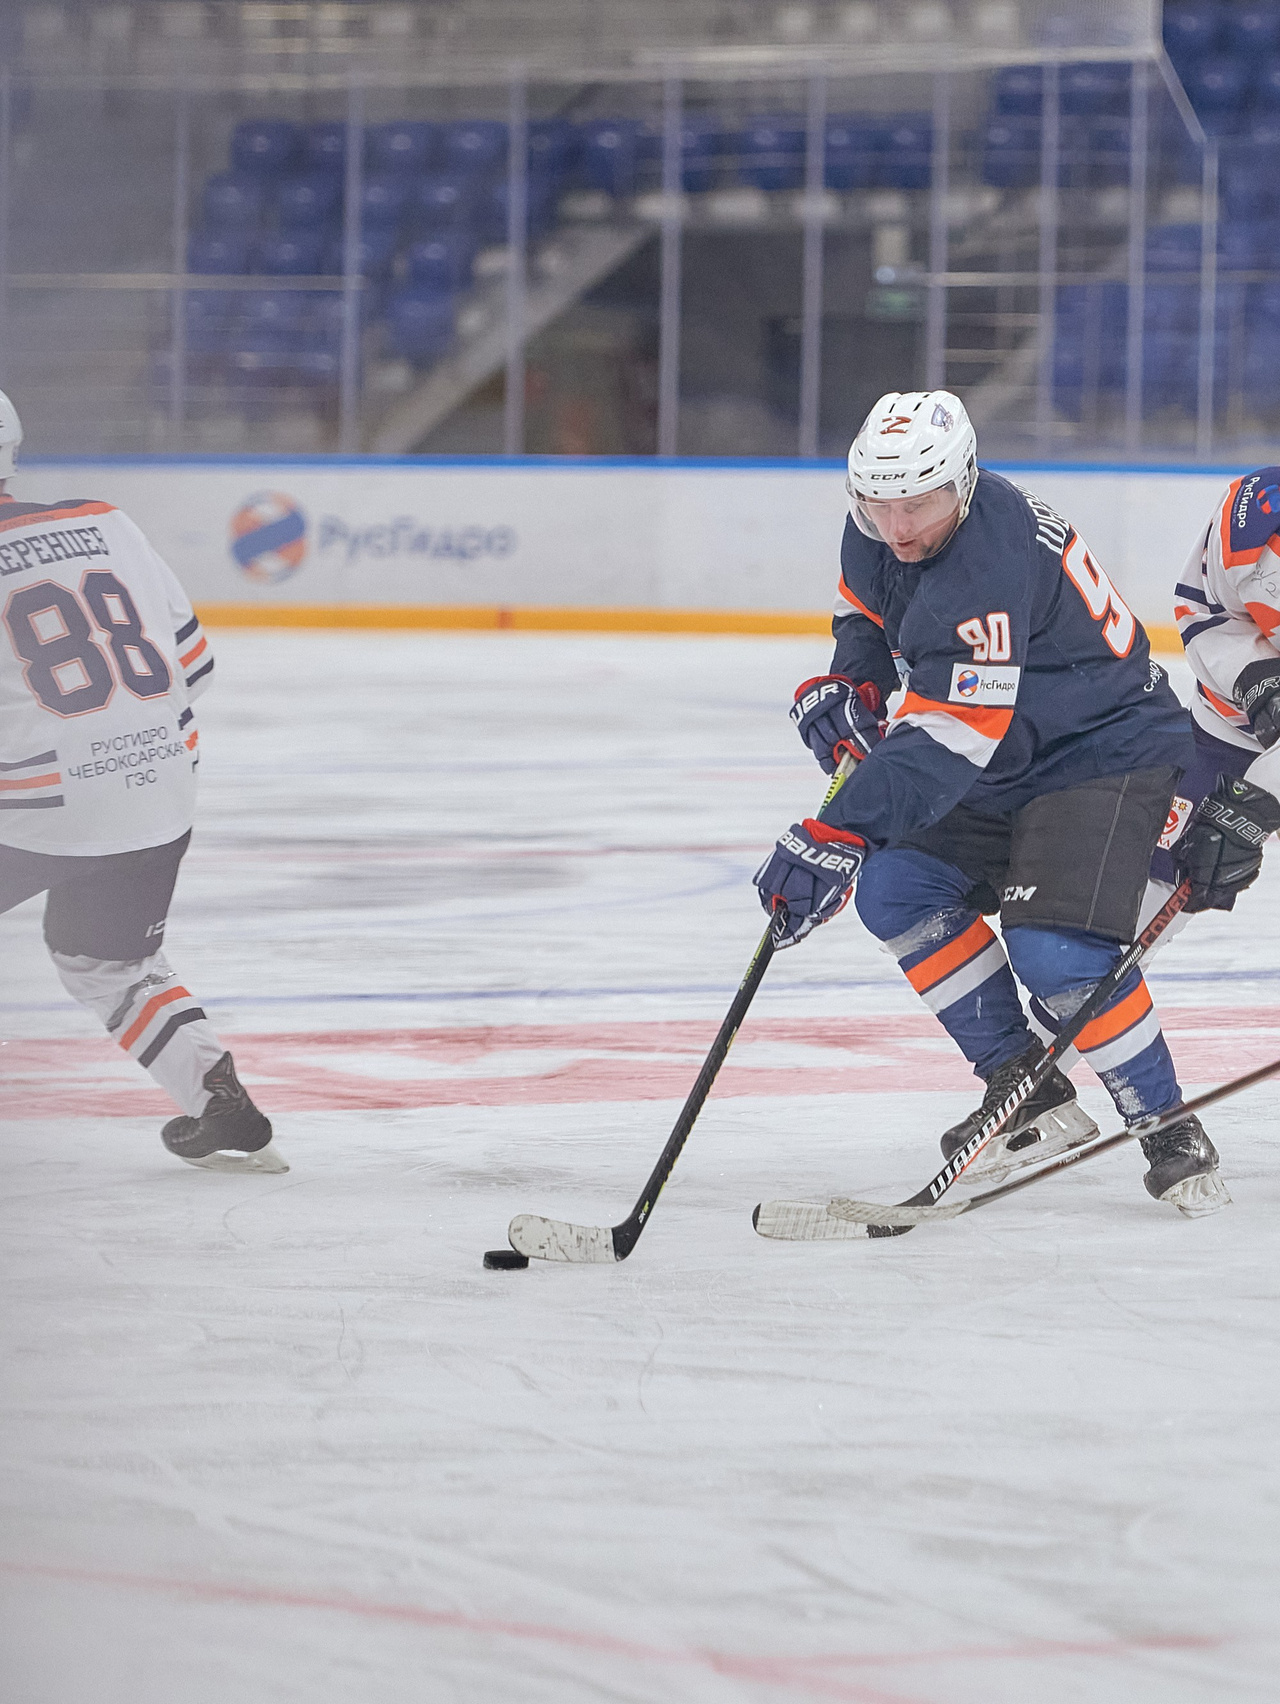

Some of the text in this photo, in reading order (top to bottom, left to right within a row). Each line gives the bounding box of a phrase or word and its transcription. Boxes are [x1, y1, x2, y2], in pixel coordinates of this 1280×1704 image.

[870, 472, 908, 481] CCM
[1236, 476, 1261, 528] РусГидро
[0, 526, 110, 577] ЕРЕНЦЕВ
[317, 512, 520, 566] РусГидро
[2, 569, 173, 719] 88
[956, 611, 1011, 662] 90
[979, 679, 1016, 692] РусГидро
[90, 726, 169, 757] РУСГИДРО
[124, 769, 158, 789] ГЭС
[777, 830, 856, 875] BAUER
[1140, 878, 1192, 949] COVER
[929, 1074, 1035, 1200] WARRIOR
